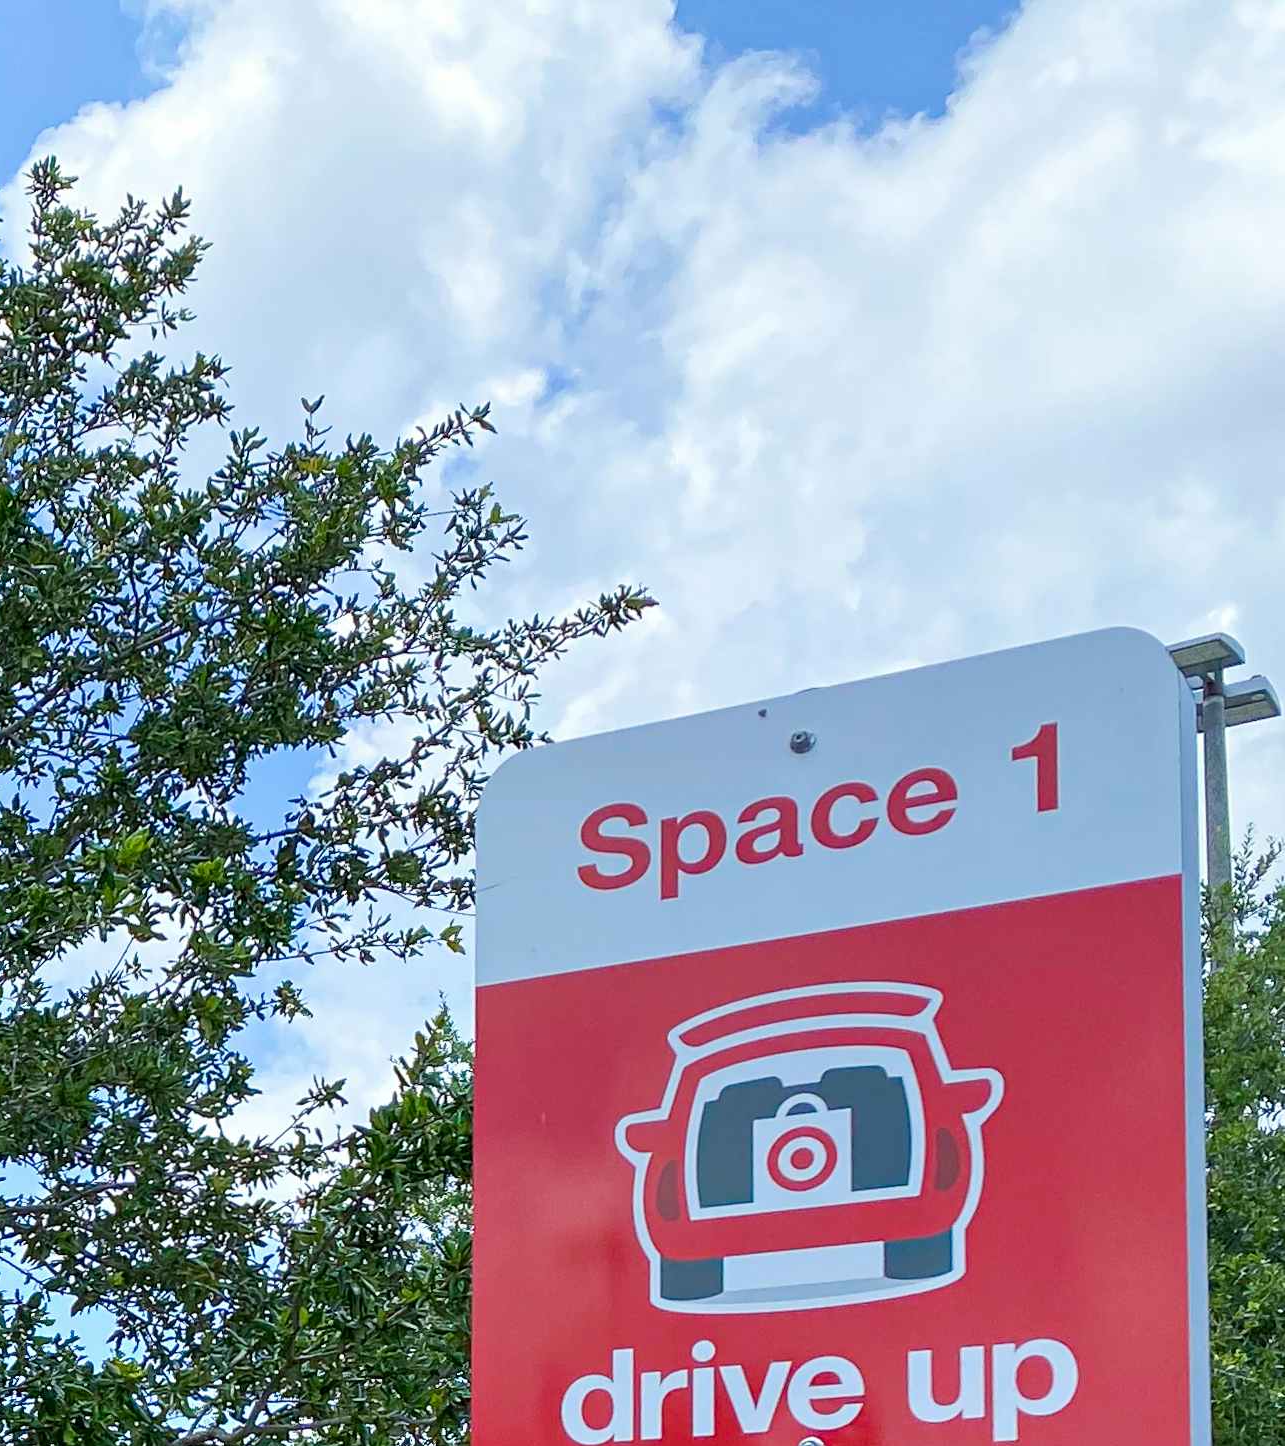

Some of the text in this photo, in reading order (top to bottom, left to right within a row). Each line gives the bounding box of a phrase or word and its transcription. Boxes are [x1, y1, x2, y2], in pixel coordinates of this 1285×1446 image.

[577, 722, 1060, 899] Space 1
[560, 1338, 1080, 1446] drive up
